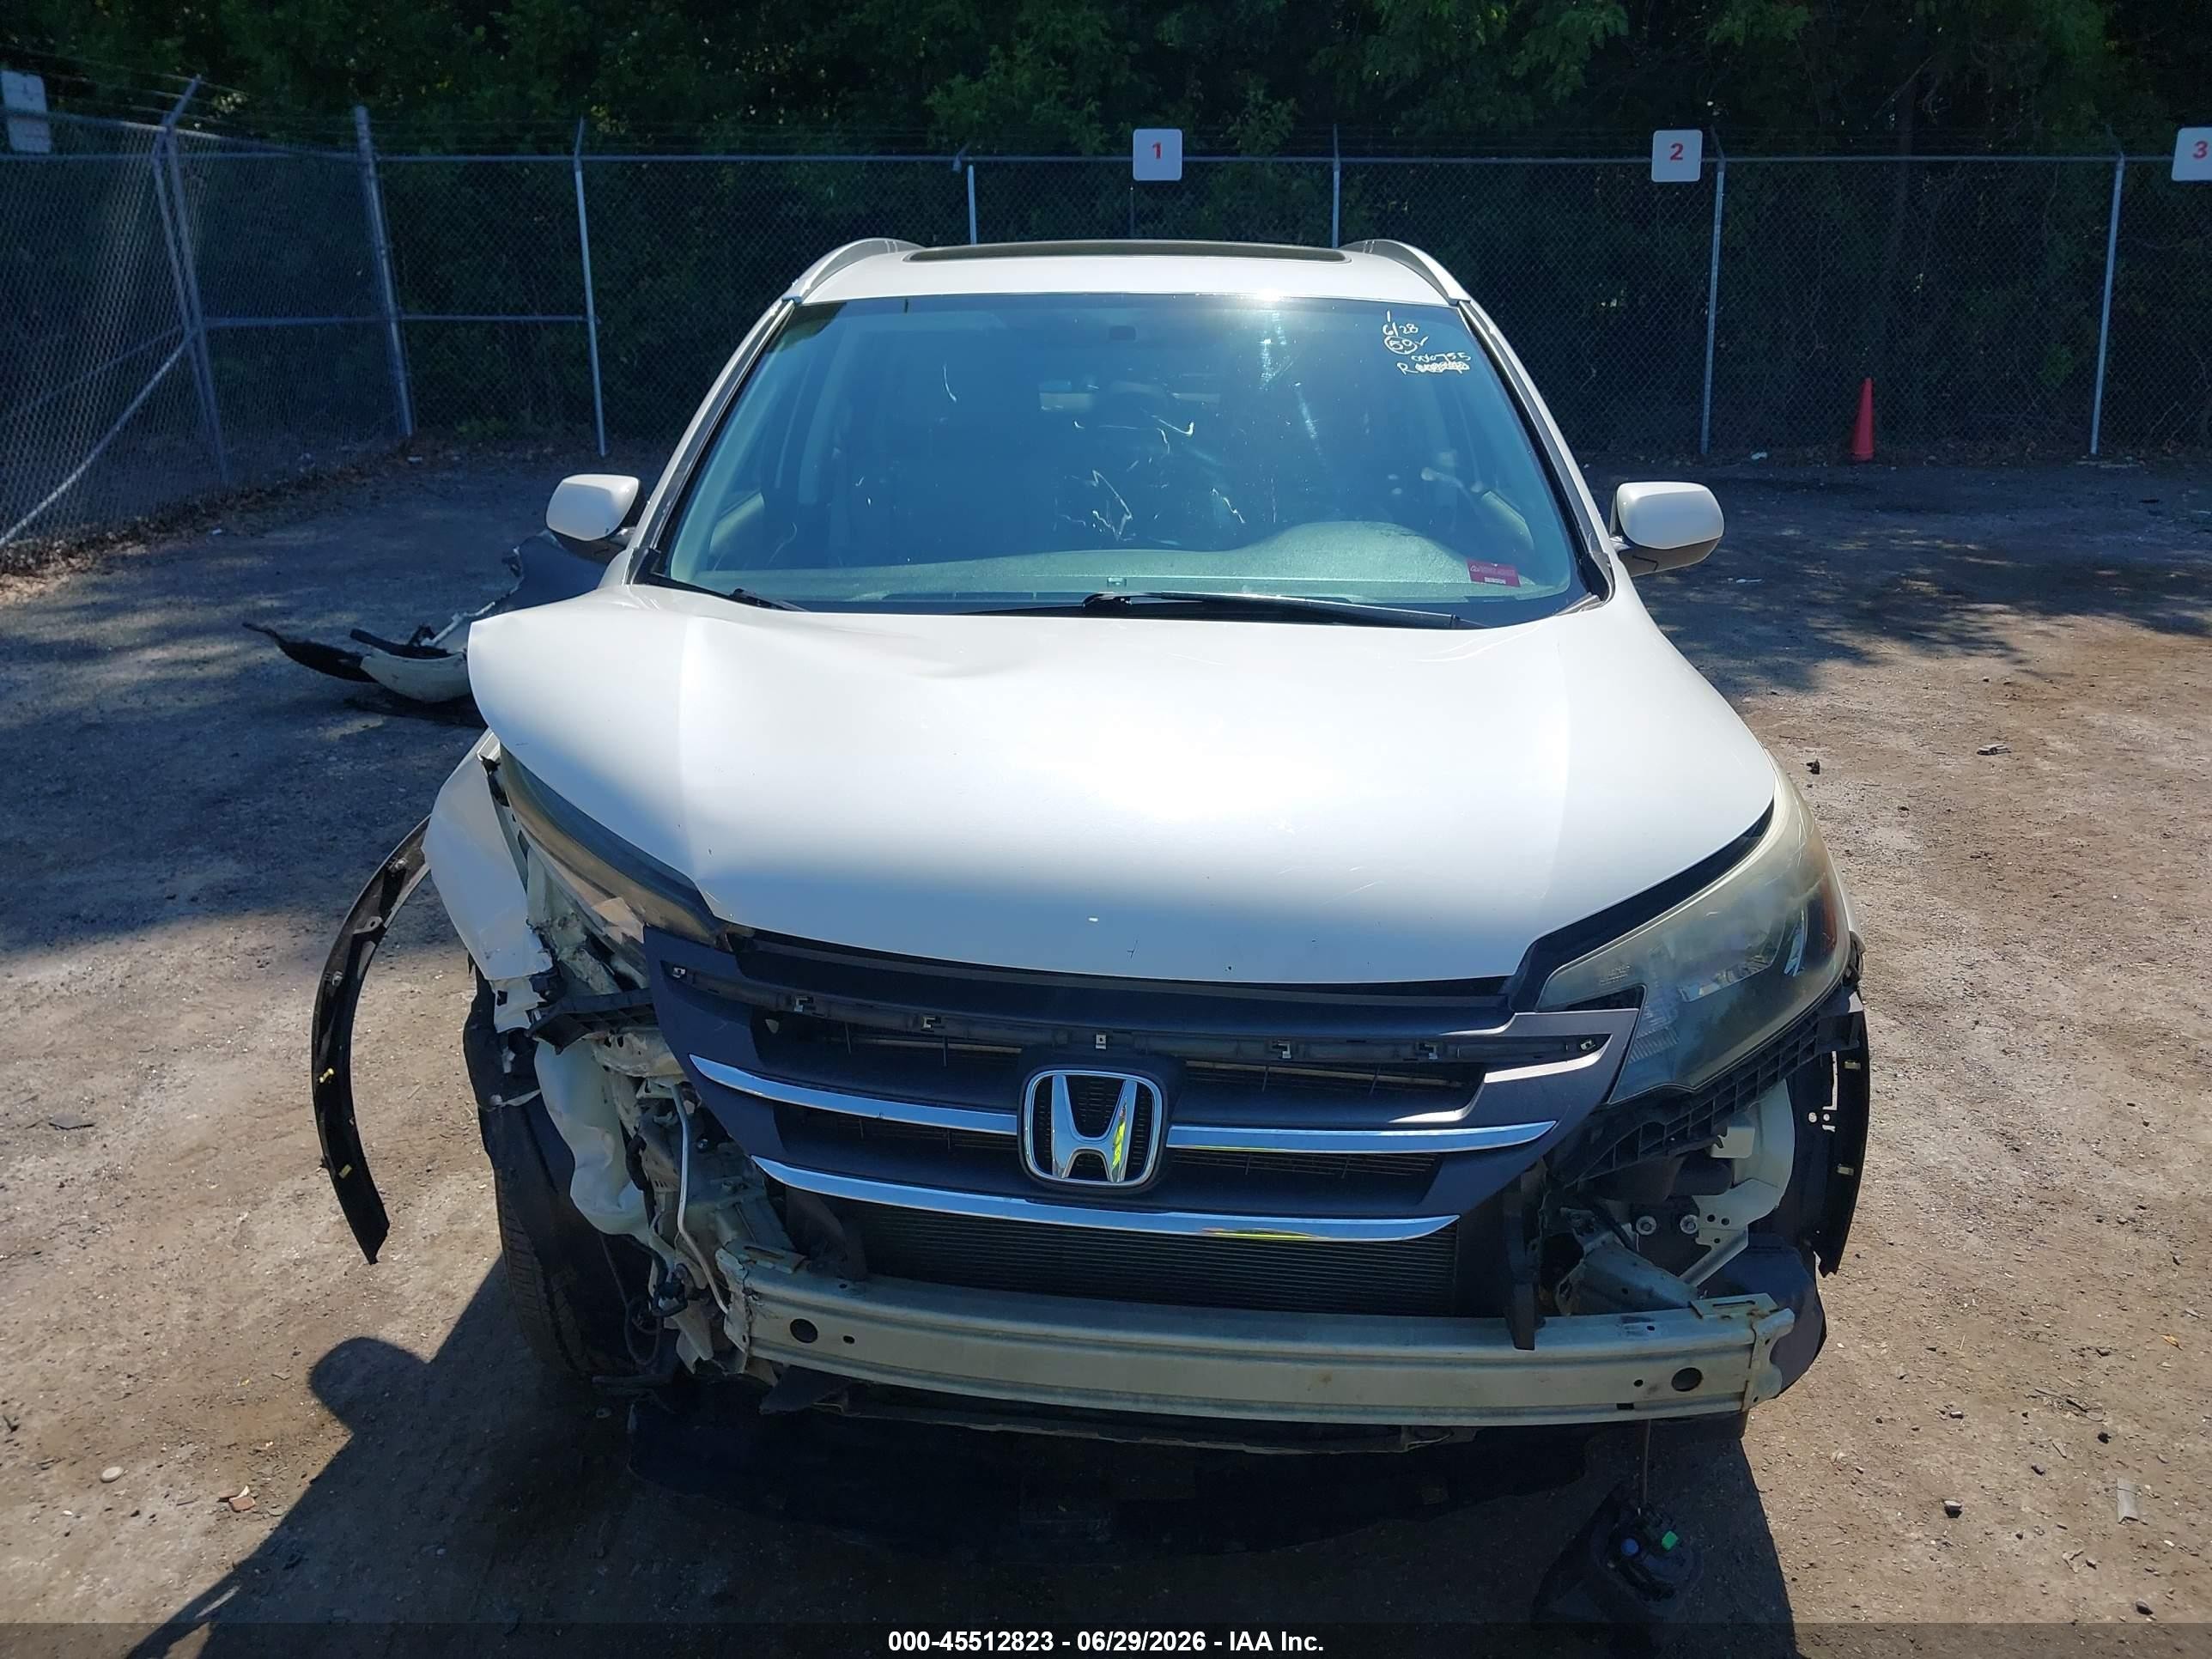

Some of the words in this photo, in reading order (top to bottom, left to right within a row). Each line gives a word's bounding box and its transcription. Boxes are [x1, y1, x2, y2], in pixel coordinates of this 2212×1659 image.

[1152, 142, 1162, 160] 1
[1669, 142, 1684, 161] 2
[2192, 140, 2209, 159] 3
[1382, 321, 1419, 337] 6/28
